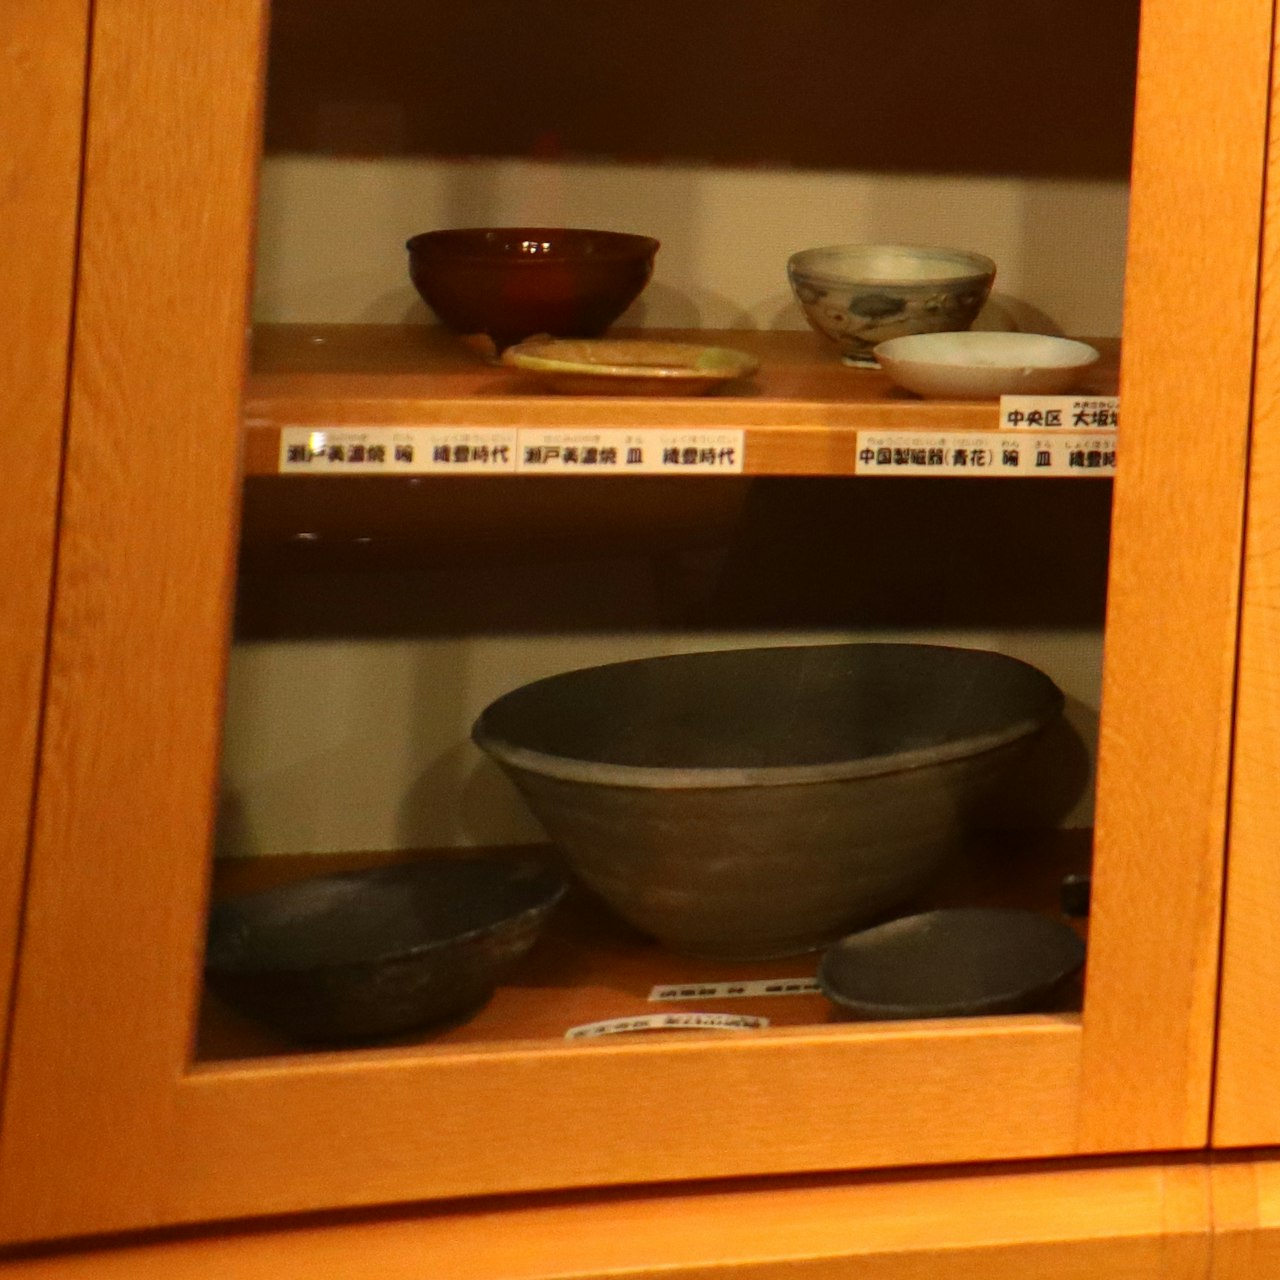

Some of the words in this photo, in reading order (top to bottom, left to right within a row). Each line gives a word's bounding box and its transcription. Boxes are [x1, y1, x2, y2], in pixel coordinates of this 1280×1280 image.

[1007, 410, 1062, 427] 中央区
[626, 448, 643, 464] 皿
[662, 447, 735, 465] 織豊時代
[1035, 451, 1052, 467] 皿
